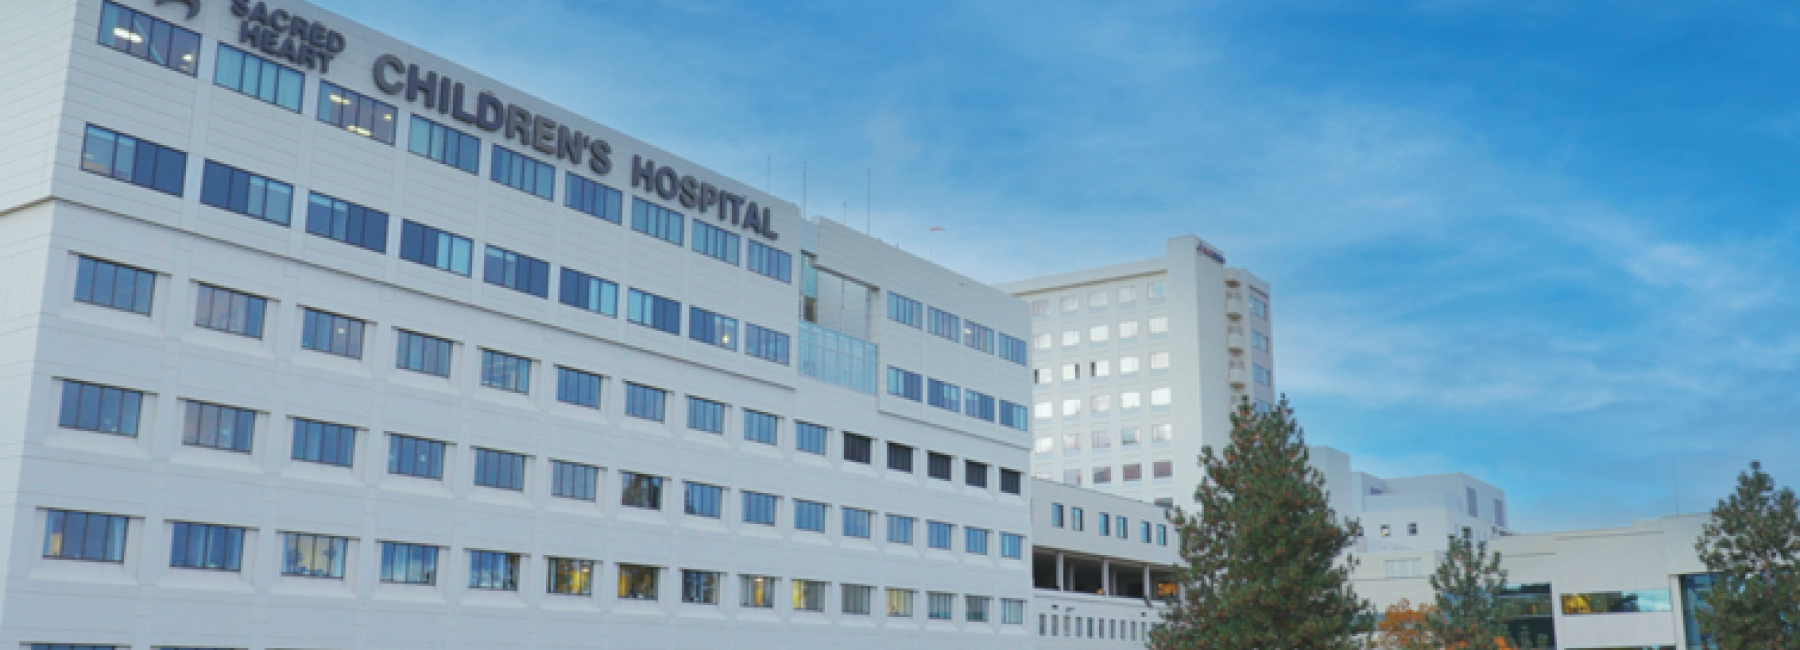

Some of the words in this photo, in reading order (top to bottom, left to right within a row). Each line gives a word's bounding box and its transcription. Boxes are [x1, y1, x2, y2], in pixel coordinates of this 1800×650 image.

[230, 0, 345, 53] SACRED
[239, 20, 335, 74] HEART
[373, 54, 612, 176] CHILDREN'S
[631, 153, 779, 240] HOSPITAL
